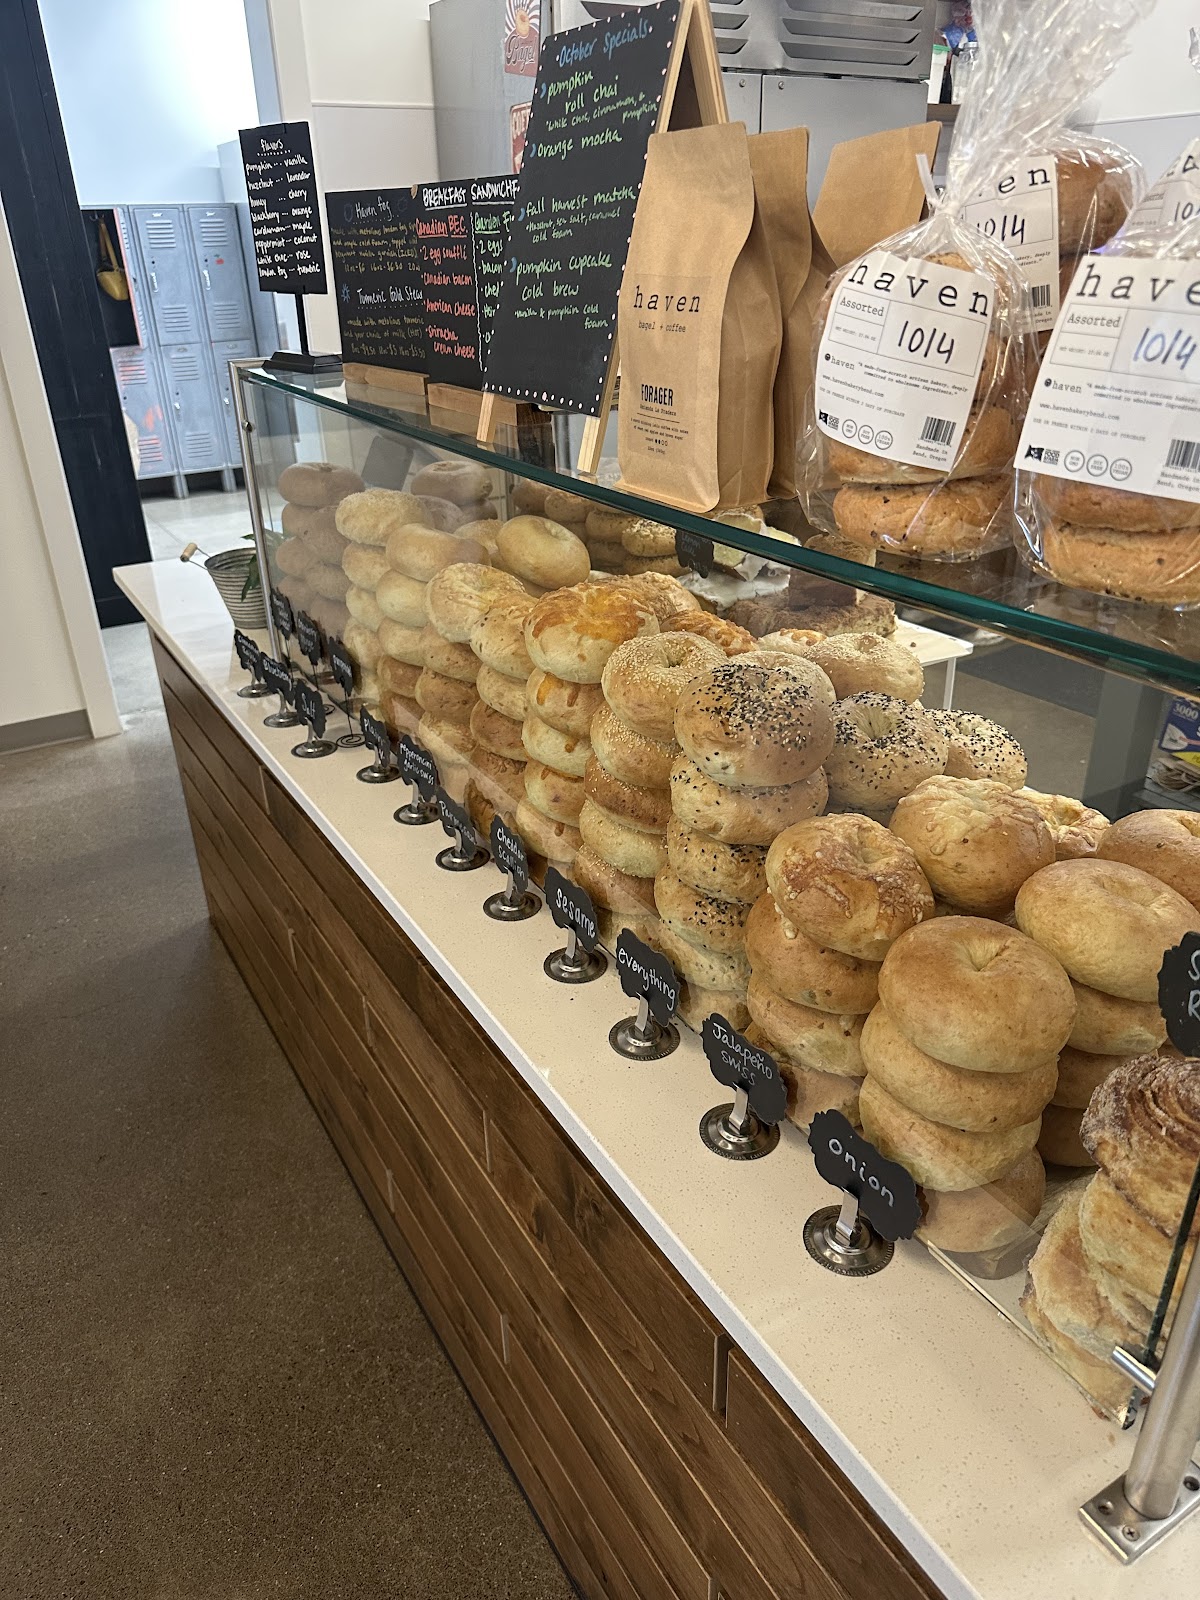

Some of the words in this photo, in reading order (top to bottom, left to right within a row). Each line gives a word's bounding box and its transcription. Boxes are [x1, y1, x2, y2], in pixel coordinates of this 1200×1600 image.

[559, 38, 597, 68] October
[603, 18, 648, 60] Specials
[548, 70, 593, 104] pumpkin
[565, 93, 584, 114] roll
[594, 75, 618, 102] chai
[622, 101, 657, 124] pumpkin
[582, 127, 622, 149] mocha
[246, 161, 273, 176] pumpkin
[284, 154, 307, 167] vanilla
[248, 178, 273, 190] hazelnut
[286, 172, 310, 184] lavender
[250, 196, 267, 212] honey
[289, 189, 307, 201] cherry
[423, 187, 467, 207] BREAKFAST
[526, 197, 545, 216] fall
[552, 194, 587, 212] harvest
[594, 185, 636, 205] matcha
[292, 206, 312, 218] orange
[355, 202, 377, 219] Haven
[292, 224, 312, 234] maple
[416, 217, 448, 235] Canadian
[475, 212, 500, 230] Garden
[255, 238, 285, 253] peppermint
[294, 234, 317, 245] coconut
[532, 232, 547, 243] cold
[552, 228, 572, 239] foam
[296, 250, 311, 260] rose
[423, 247, 428, 261] 2
[430, 248, 442, 266] egg
[479, 240, 485, 254] 2
[487, 239, 503, 257] eggs
[482, 262, 503, 275] bacon
[516, 258, 561, 285] pumpkin
[569, 251, 612, 275] cupcake
[453, 273, 472, 286] bacon
[553, 280, 579, 296] brew
[848, 258, 990, 317] haven
[426, 300, 452, 314] American
[633, 285, 701, 313] haven
[840, 296, 884, 317] Assorted
[548, 306, 579, 321] pumpkin
[1067, 313, 1121, 329] Assorted
[585, 317, 608, 329] foam
[638, 321, 655, 331] bagel
[666, 324, 686, 333] coffee
[831, 356, 855, 370] haven
[641, 384, 673, 406] FORAGER
[1051, 379, 1082, 394] haven
[618, 947, 675, 1011] everything
[713, 1022, 773, 1080] Jalapeño
